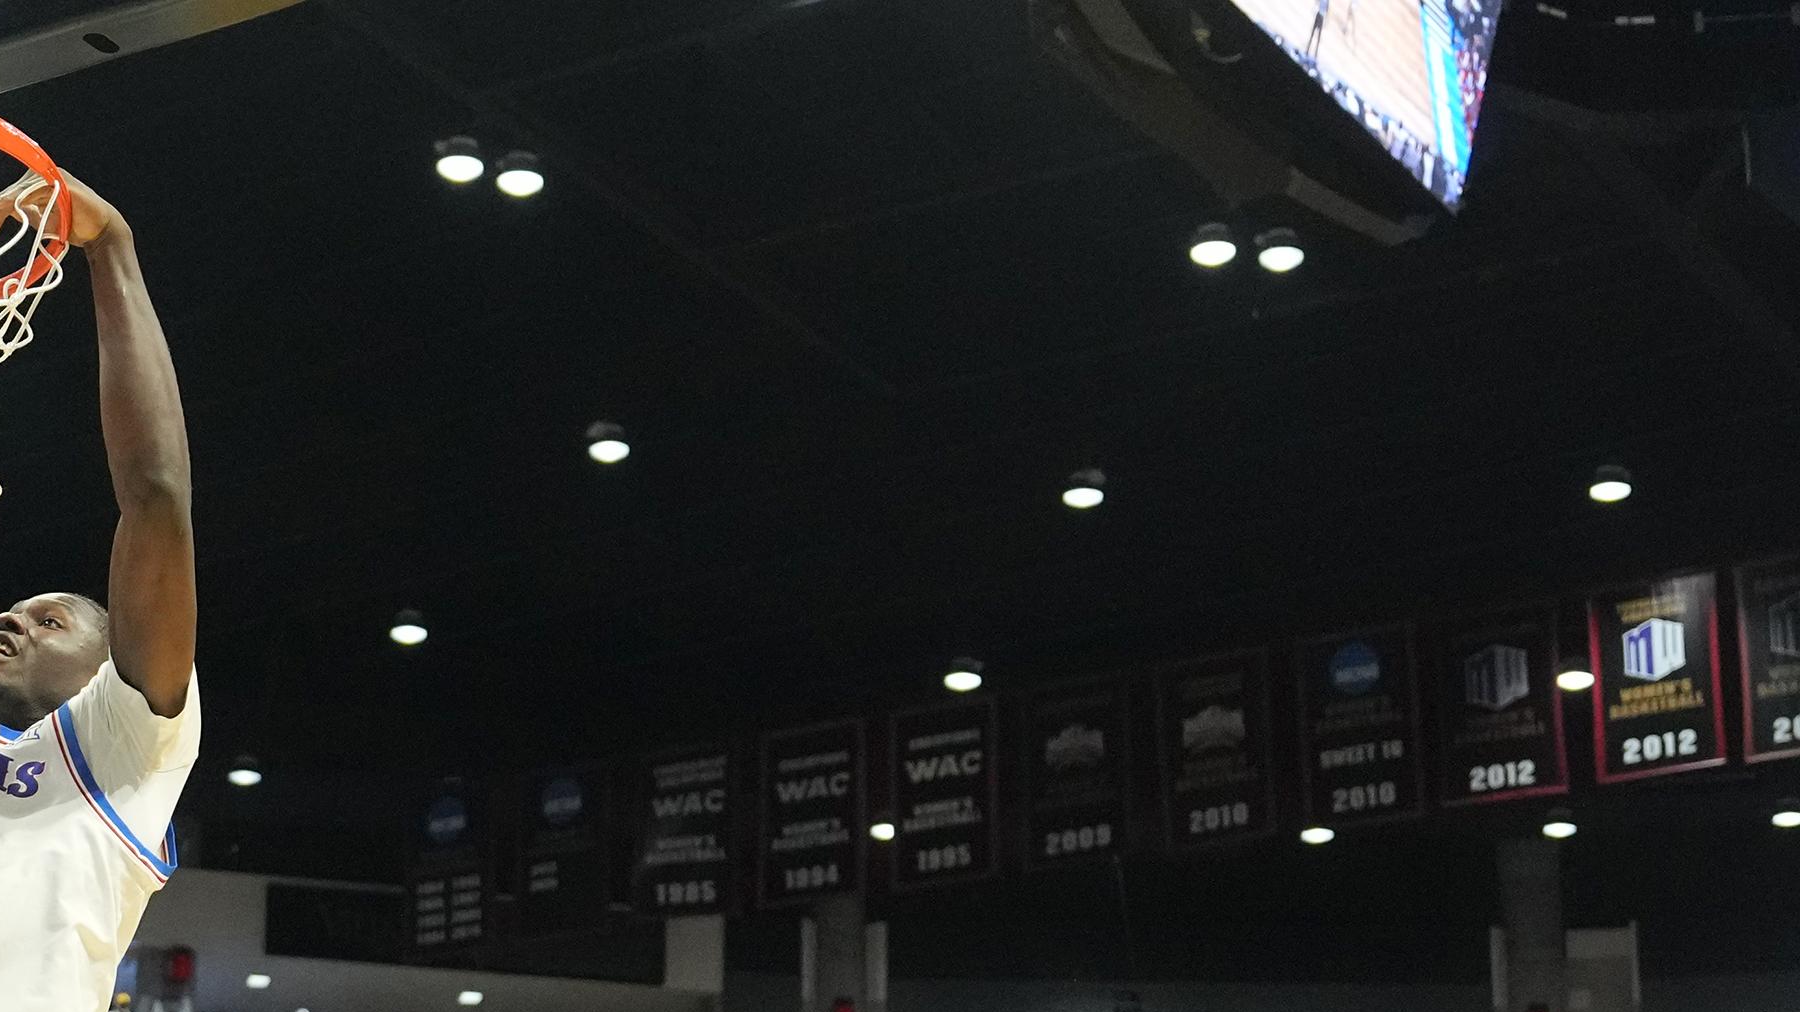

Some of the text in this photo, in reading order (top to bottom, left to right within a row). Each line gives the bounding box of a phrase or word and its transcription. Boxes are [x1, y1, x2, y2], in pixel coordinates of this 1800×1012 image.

[1622, 728, 1698, 765] 2012
[905, 750, 983, 784] WAC
[1468, 759, 1536, 792] 2012
[652, 789, 727, 817] WAC
[776, 771, 850, 803] WAC
